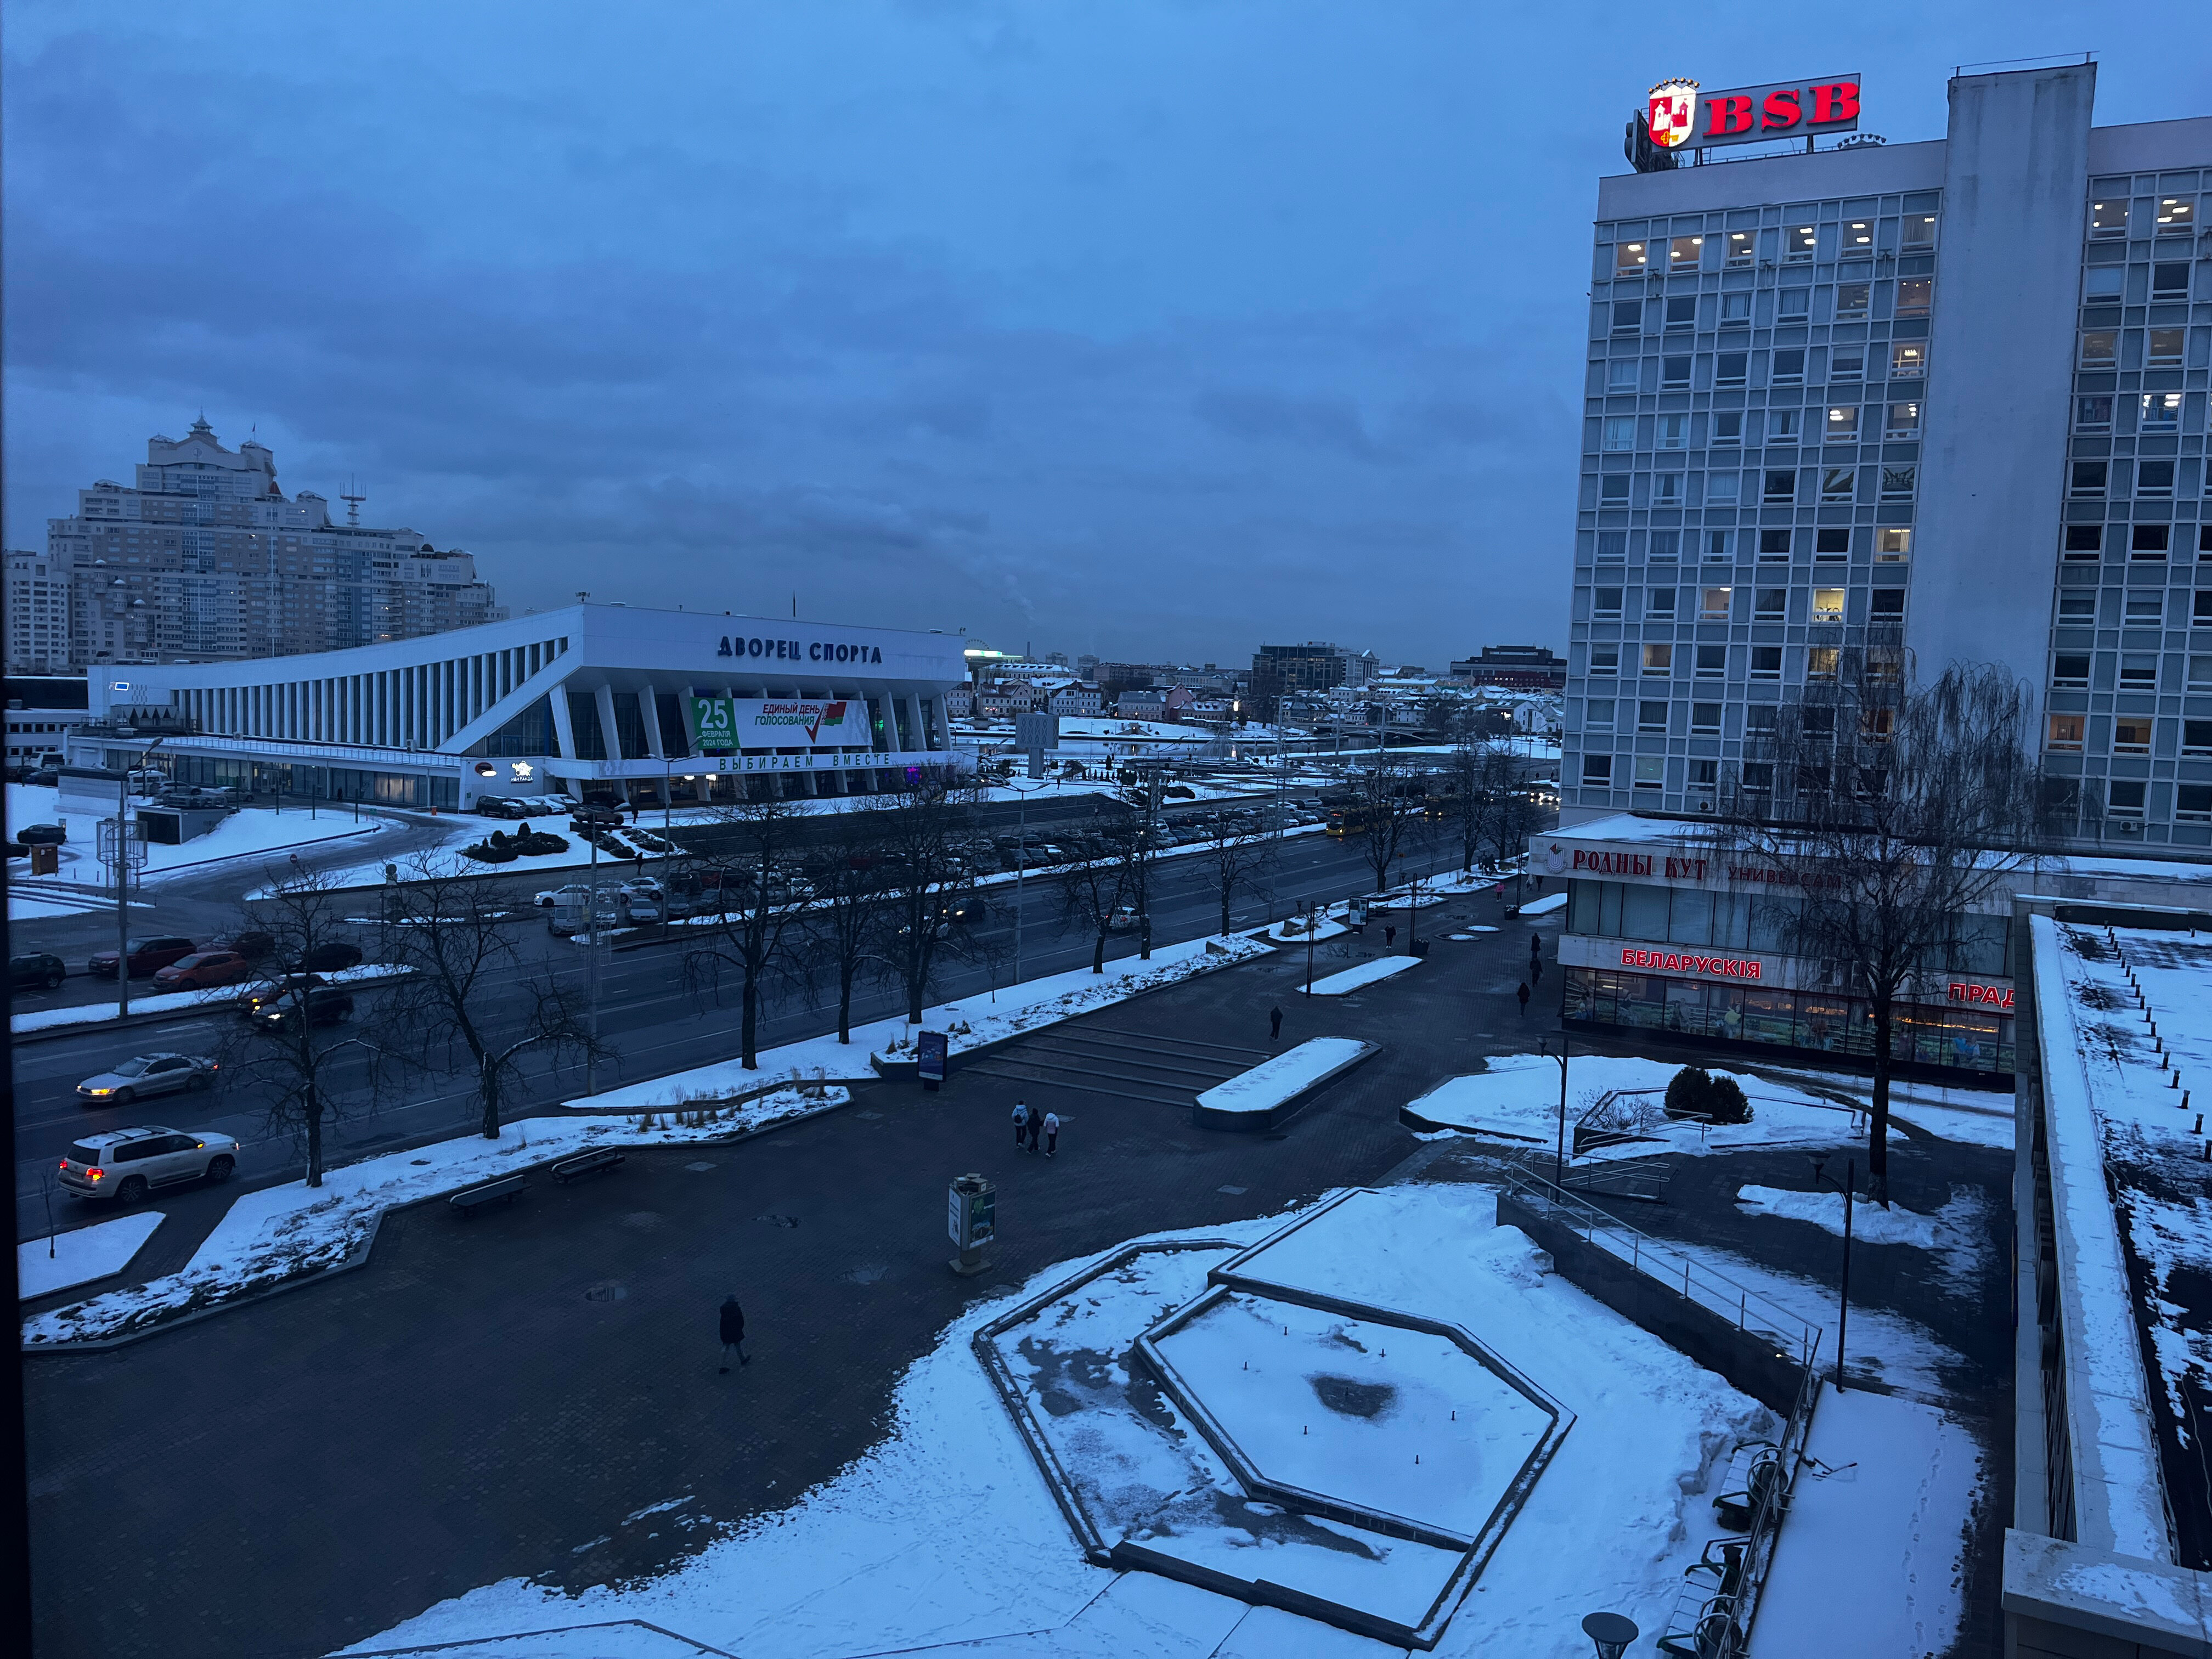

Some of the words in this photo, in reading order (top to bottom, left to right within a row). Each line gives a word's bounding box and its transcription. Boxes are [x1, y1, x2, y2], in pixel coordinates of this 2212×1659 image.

[1702, 82, 1860, 137] BSB
[718, 636, 802, 660] ДВОРЕЦ
[809, 642, 882, 663] СПОРТА
[698, 699, 729, 729] 25
[754, 715, 815, 726] ГОЛОСОВАНИЯ
[763, 702, 798, 716] ЕДИНЫЙ
[798, 704, 820, 716] ДЕНЬ
[702, 738, 716, 747] 2024
[719, 755, 813, 770] ВЫБИРАЕМ
[833, 753, 889, 767] ВМЕСТЕ
[1573, 849, 1652, 876] РОДНЫ
[1664, 855, 1708, 881] КУТ
[1621, 948, 1762, 979] БЕЛАРУСКІЯ
